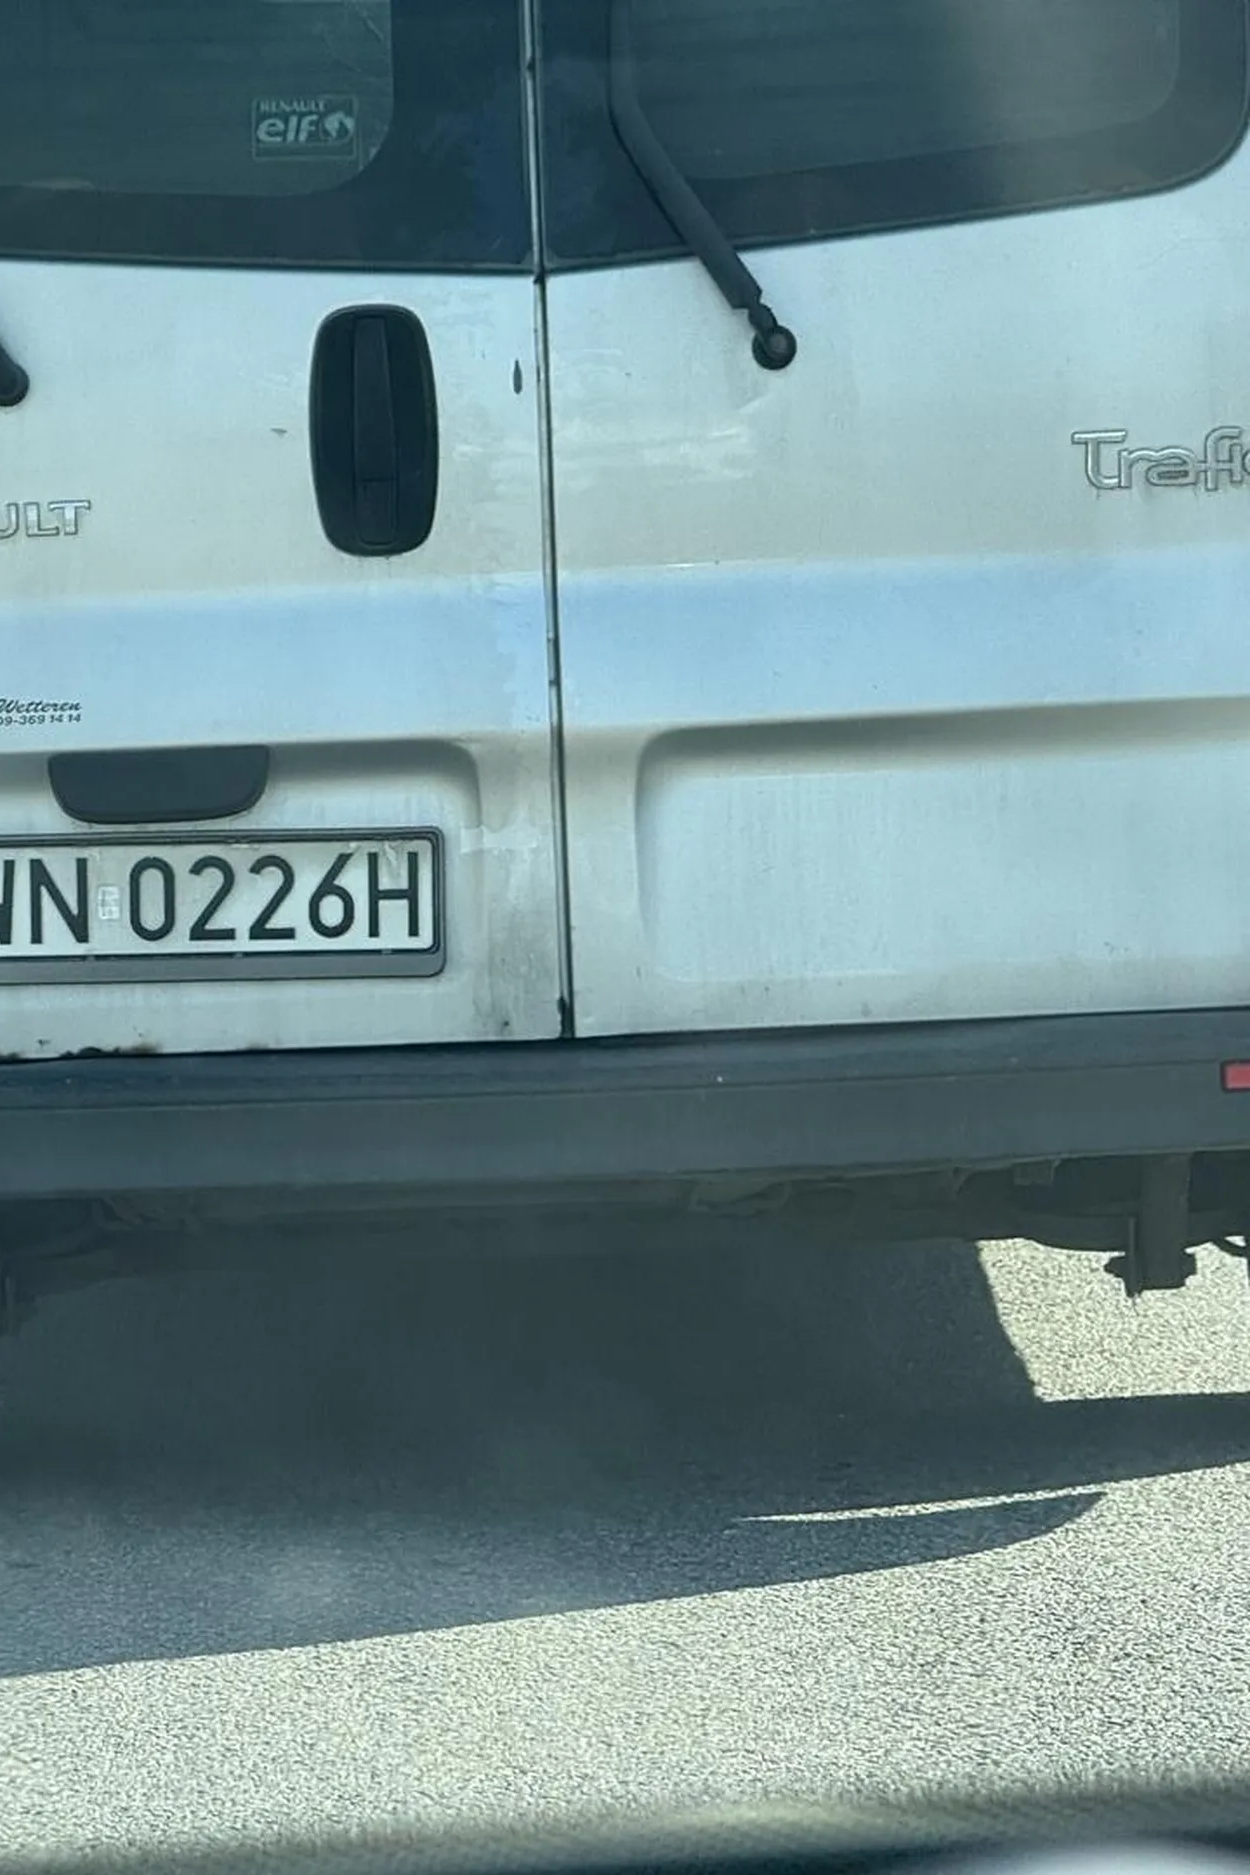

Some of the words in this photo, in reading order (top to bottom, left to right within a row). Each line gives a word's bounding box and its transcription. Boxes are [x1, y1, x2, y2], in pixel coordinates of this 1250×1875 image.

[257, 114, 319, 143] elf
[1071, 425, 1250, 491] Trafi
[128, 851, 420, 942] 0226H
